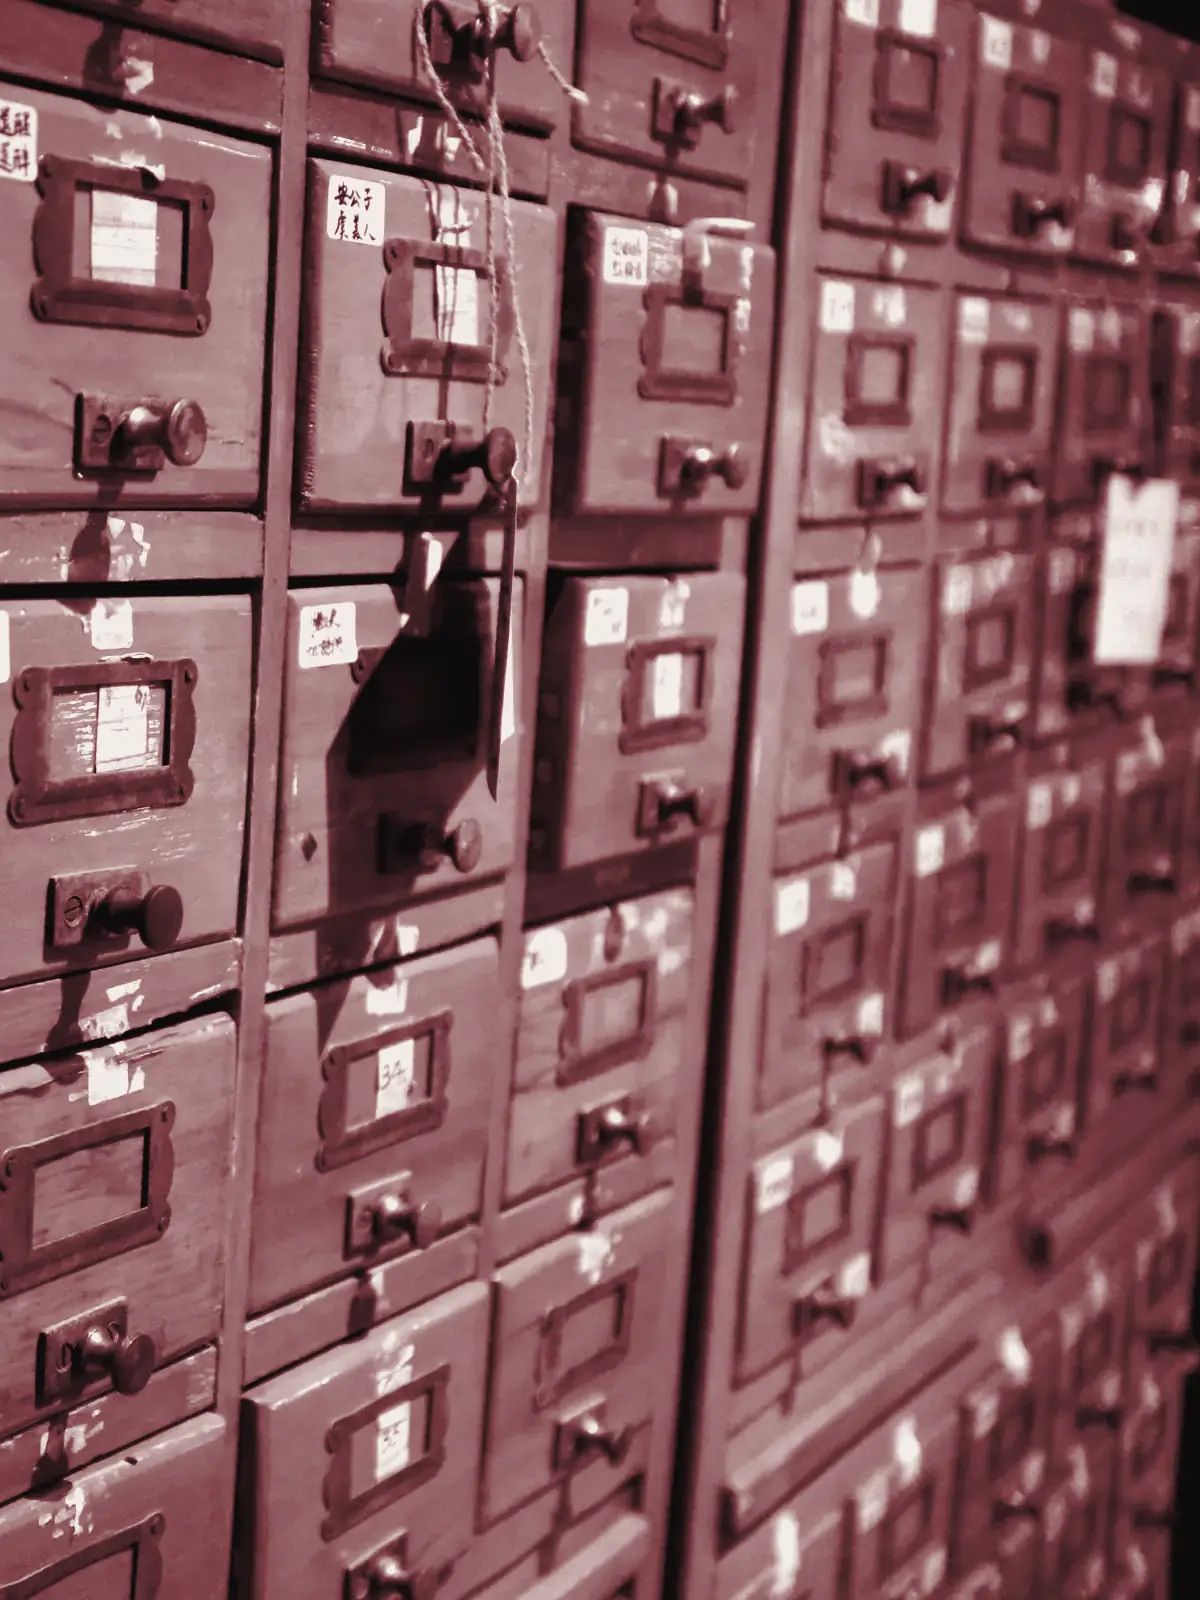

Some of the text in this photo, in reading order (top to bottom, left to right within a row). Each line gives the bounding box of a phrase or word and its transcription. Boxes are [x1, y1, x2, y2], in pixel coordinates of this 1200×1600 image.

[334, 181, 373, 211] 安公子
[334, 210, 377, 241] 虞美人
